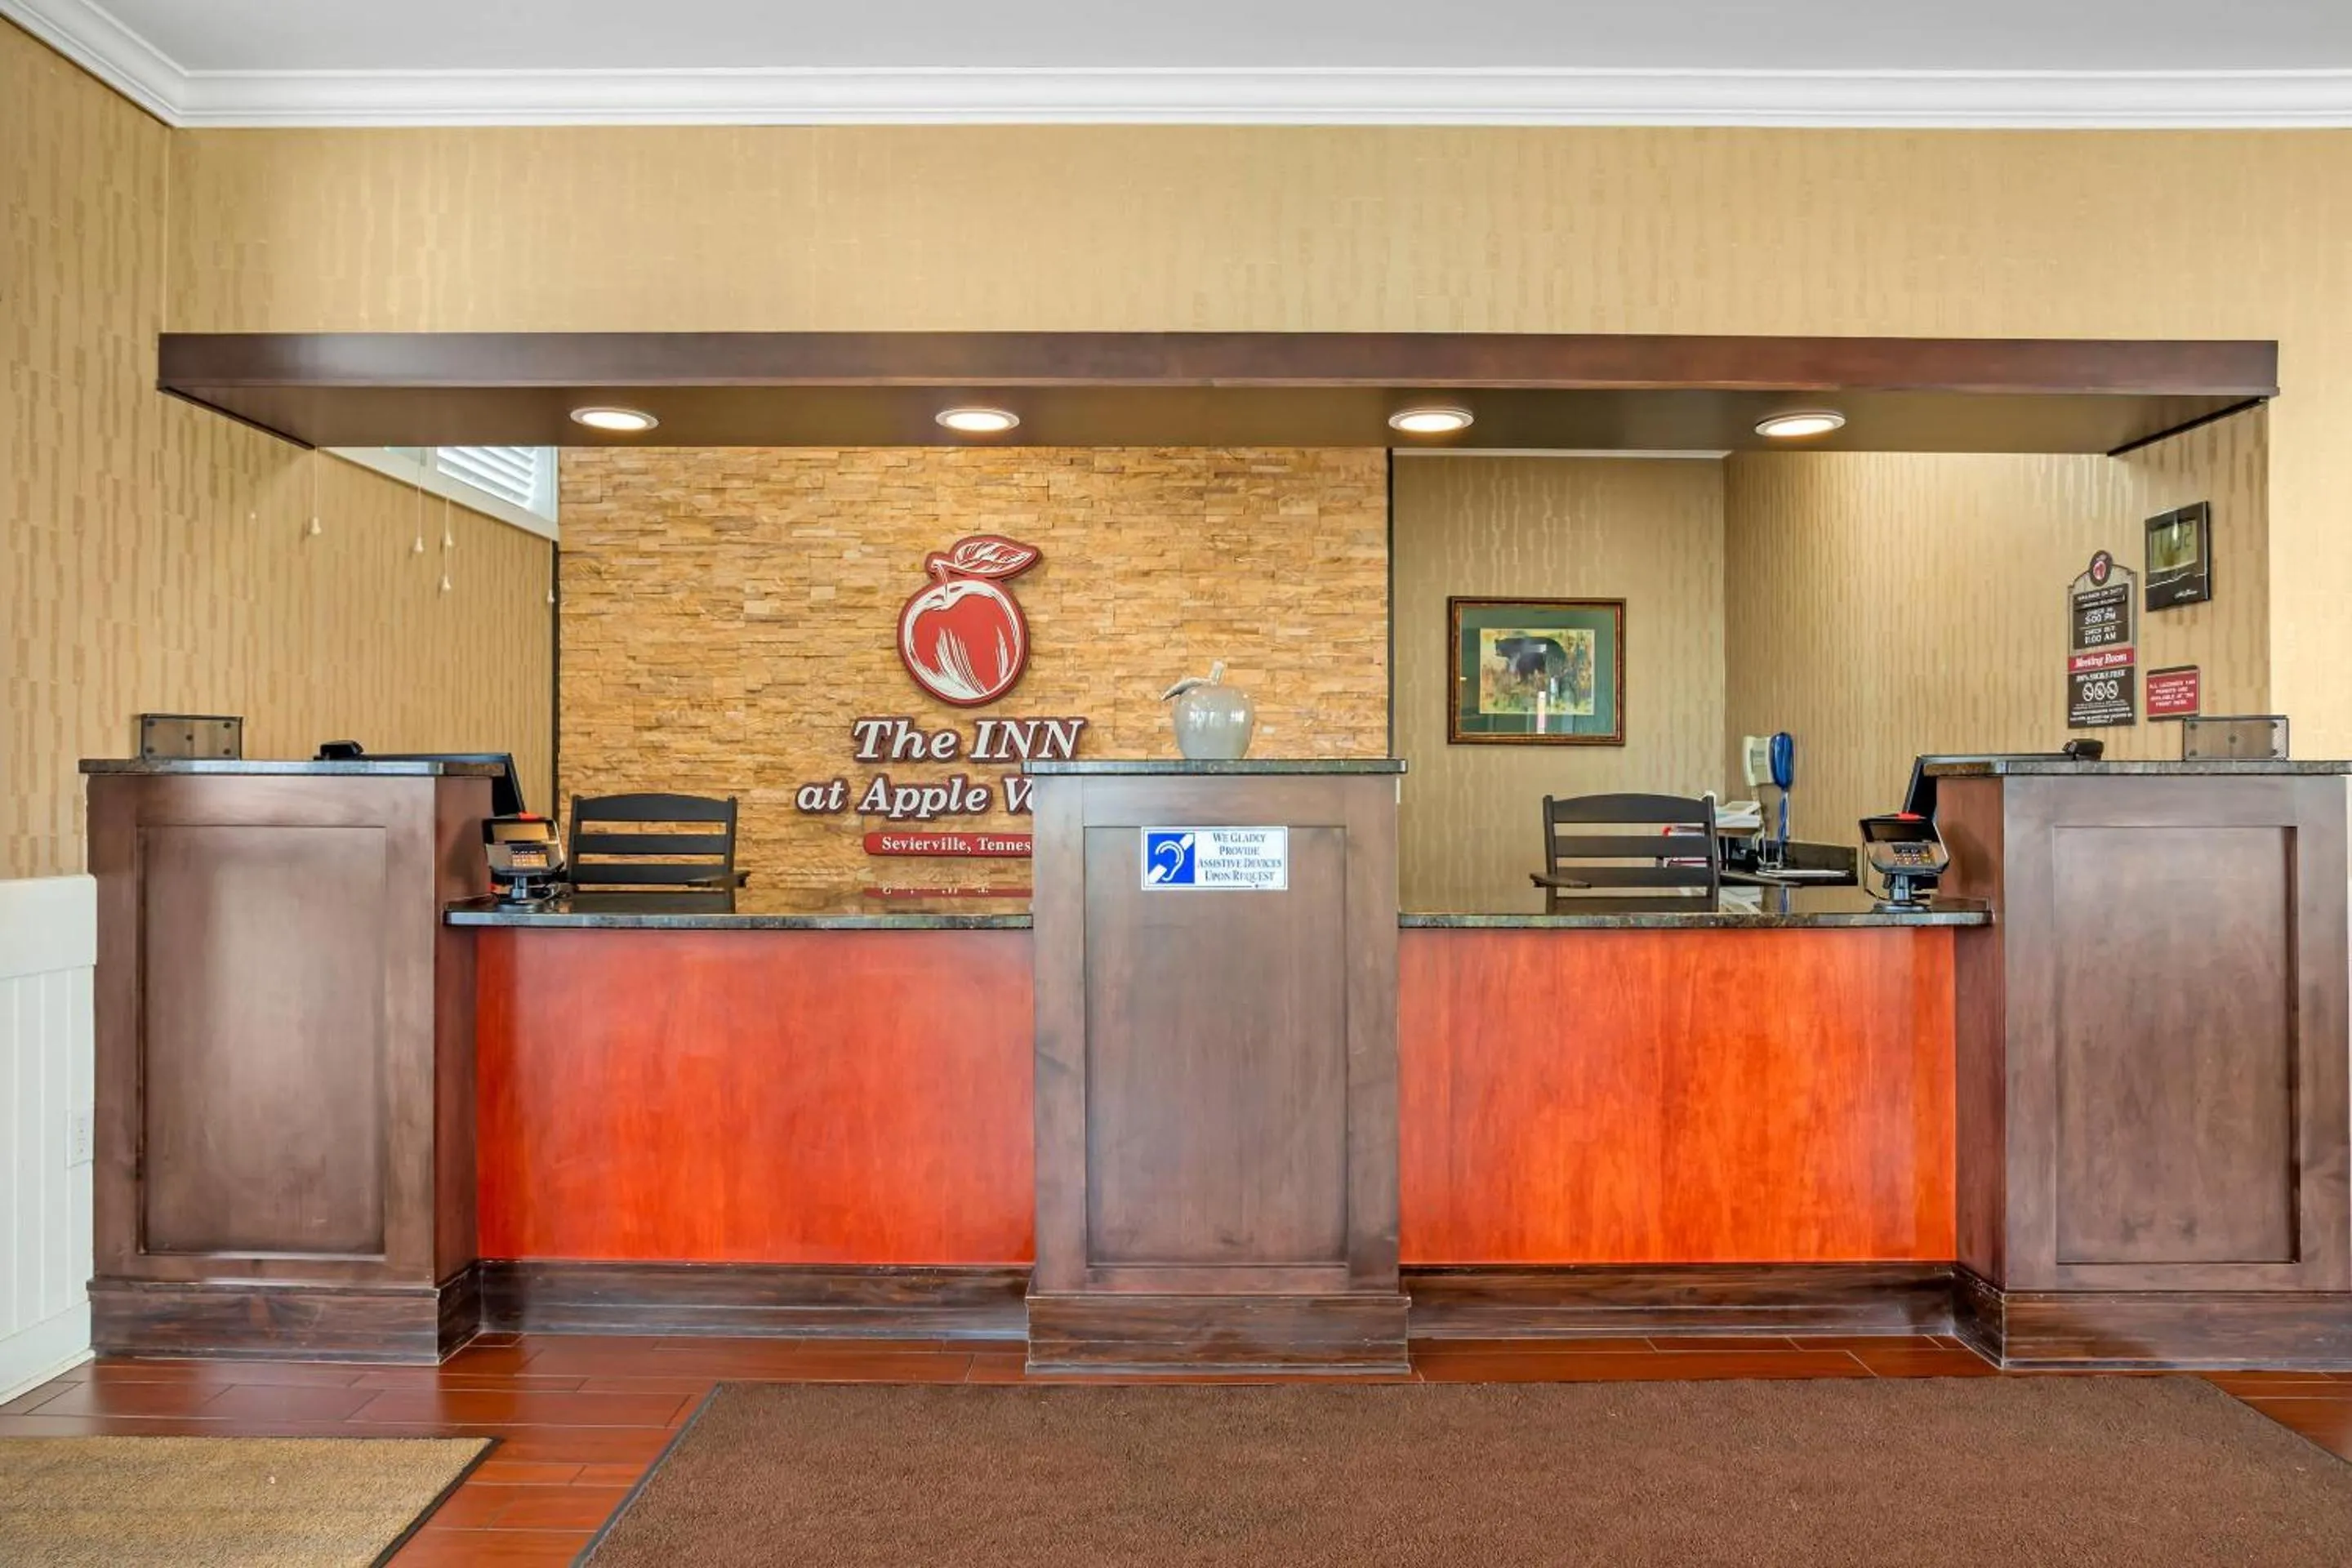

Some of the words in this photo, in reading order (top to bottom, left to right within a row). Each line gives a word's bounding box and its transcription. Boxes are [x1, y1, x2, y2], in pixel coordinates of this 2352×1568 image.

[2103, 631, 2117, 641] AM
[2105, 653, 2127, 664] Room
[853, 717, 959, 761] The
[969, 717, 1088, 761] INN
[796, 777, 850, 814] at
[857, 775, 992, 821] Apple
[882, 835, 973, 853] Sevierville,
[1213, 831, 1229, 844] WE
[1230, 831, 1267, 844] GLADLY
[1219, 845, 1260, 856] PROVIDE
[1197, 858, 1241, 869] ASSISTIVE
[1244, 858, 1282, 868] DEVICES
[1205, 870, 1232, 881] UPON
[1232, 870, 1276, 883] REQUEST
